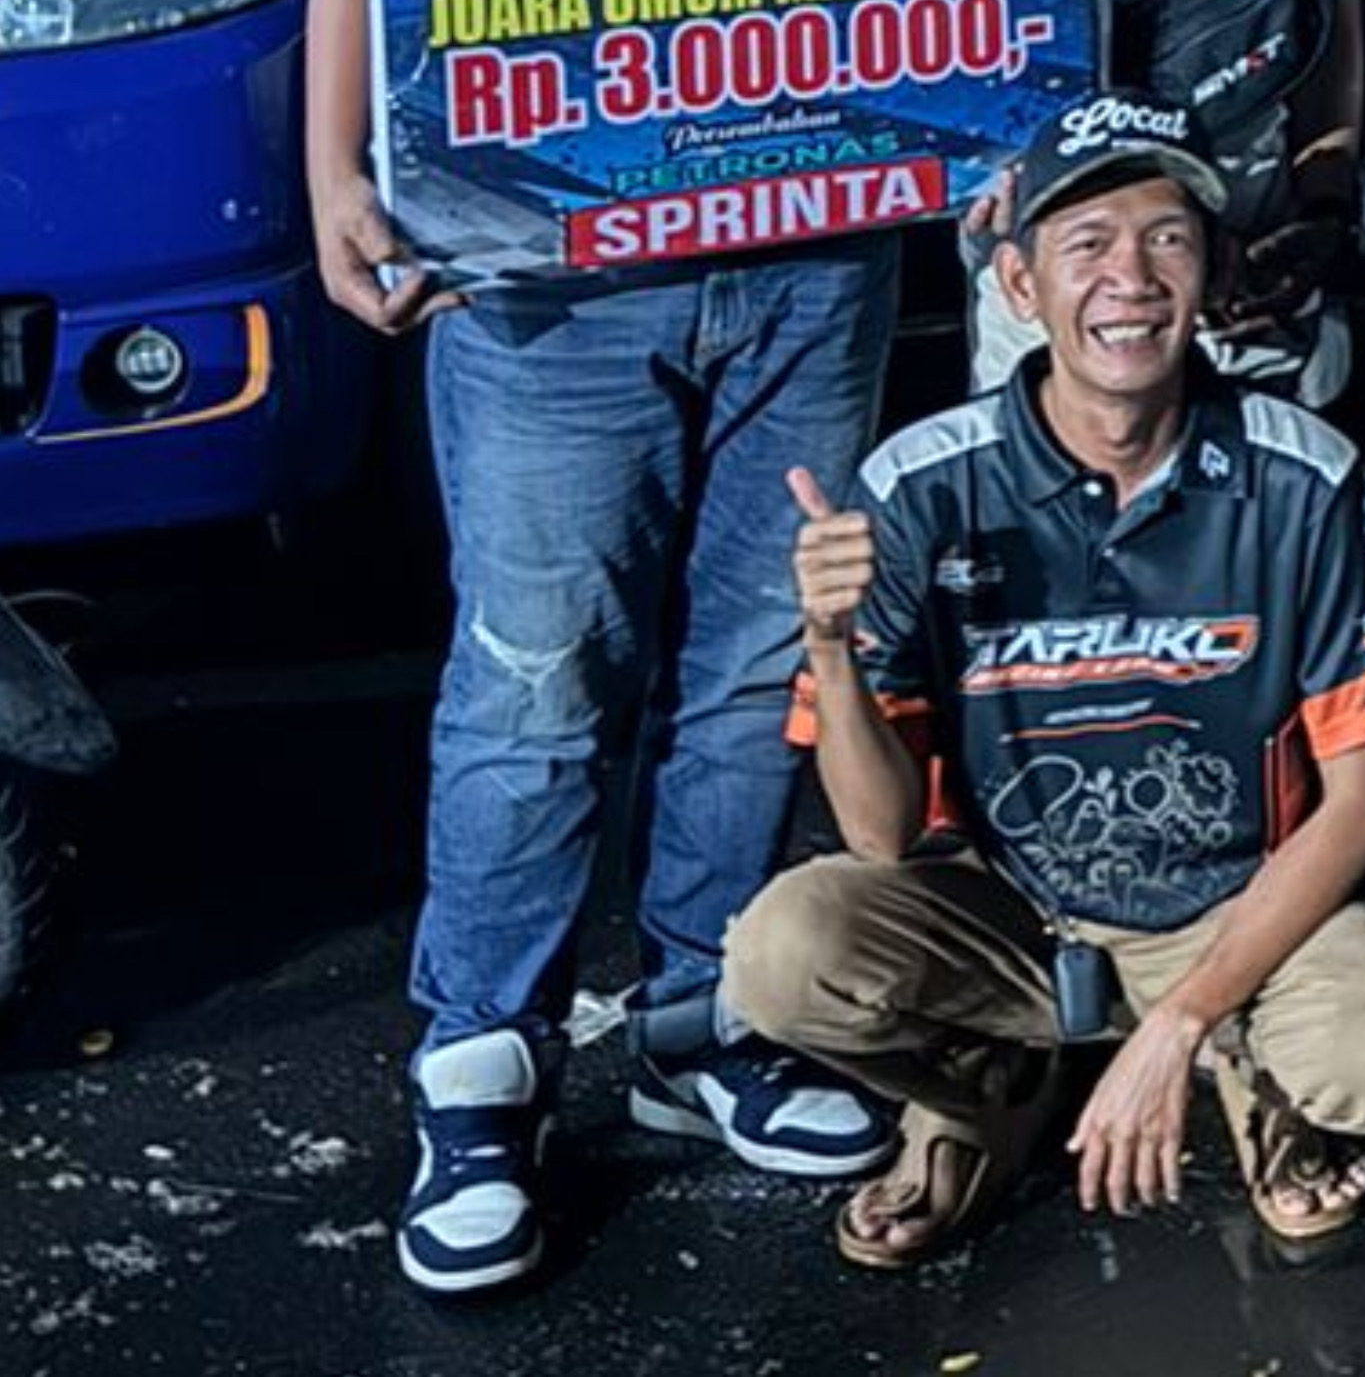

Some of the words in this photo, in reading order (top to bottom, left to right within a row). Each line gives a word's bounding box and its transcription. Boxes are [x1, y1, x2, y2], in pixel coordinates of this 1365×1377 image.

[445, 45, 588, 149] Rp.
[1056, 95, 1189, 157] Local
[615, 130, 900, 195] PETRONAS
[591, 165, 926, 260] SPRINTA
[962, 614, 1261, 678] TARUKO
